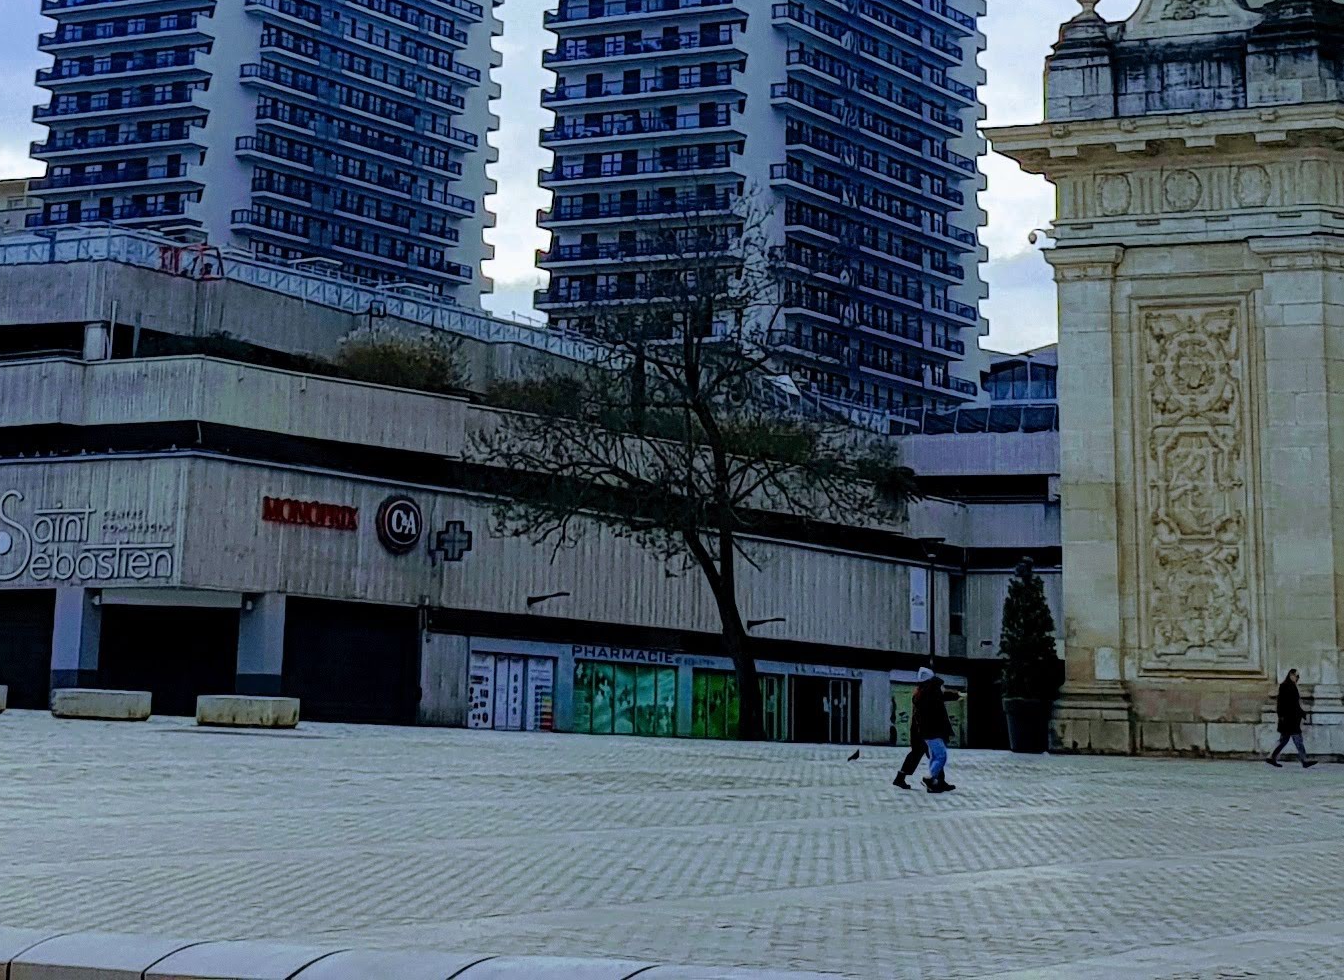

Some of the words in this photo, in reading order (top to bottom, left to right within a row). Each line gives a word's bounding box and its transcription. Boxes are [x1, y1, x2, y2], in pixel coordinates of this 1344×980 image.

[262, 496, 358, 530] MONOPRIX
[392, 509, 418, 535] C&A
[571, 645, 674, 664] PHARMACIE
